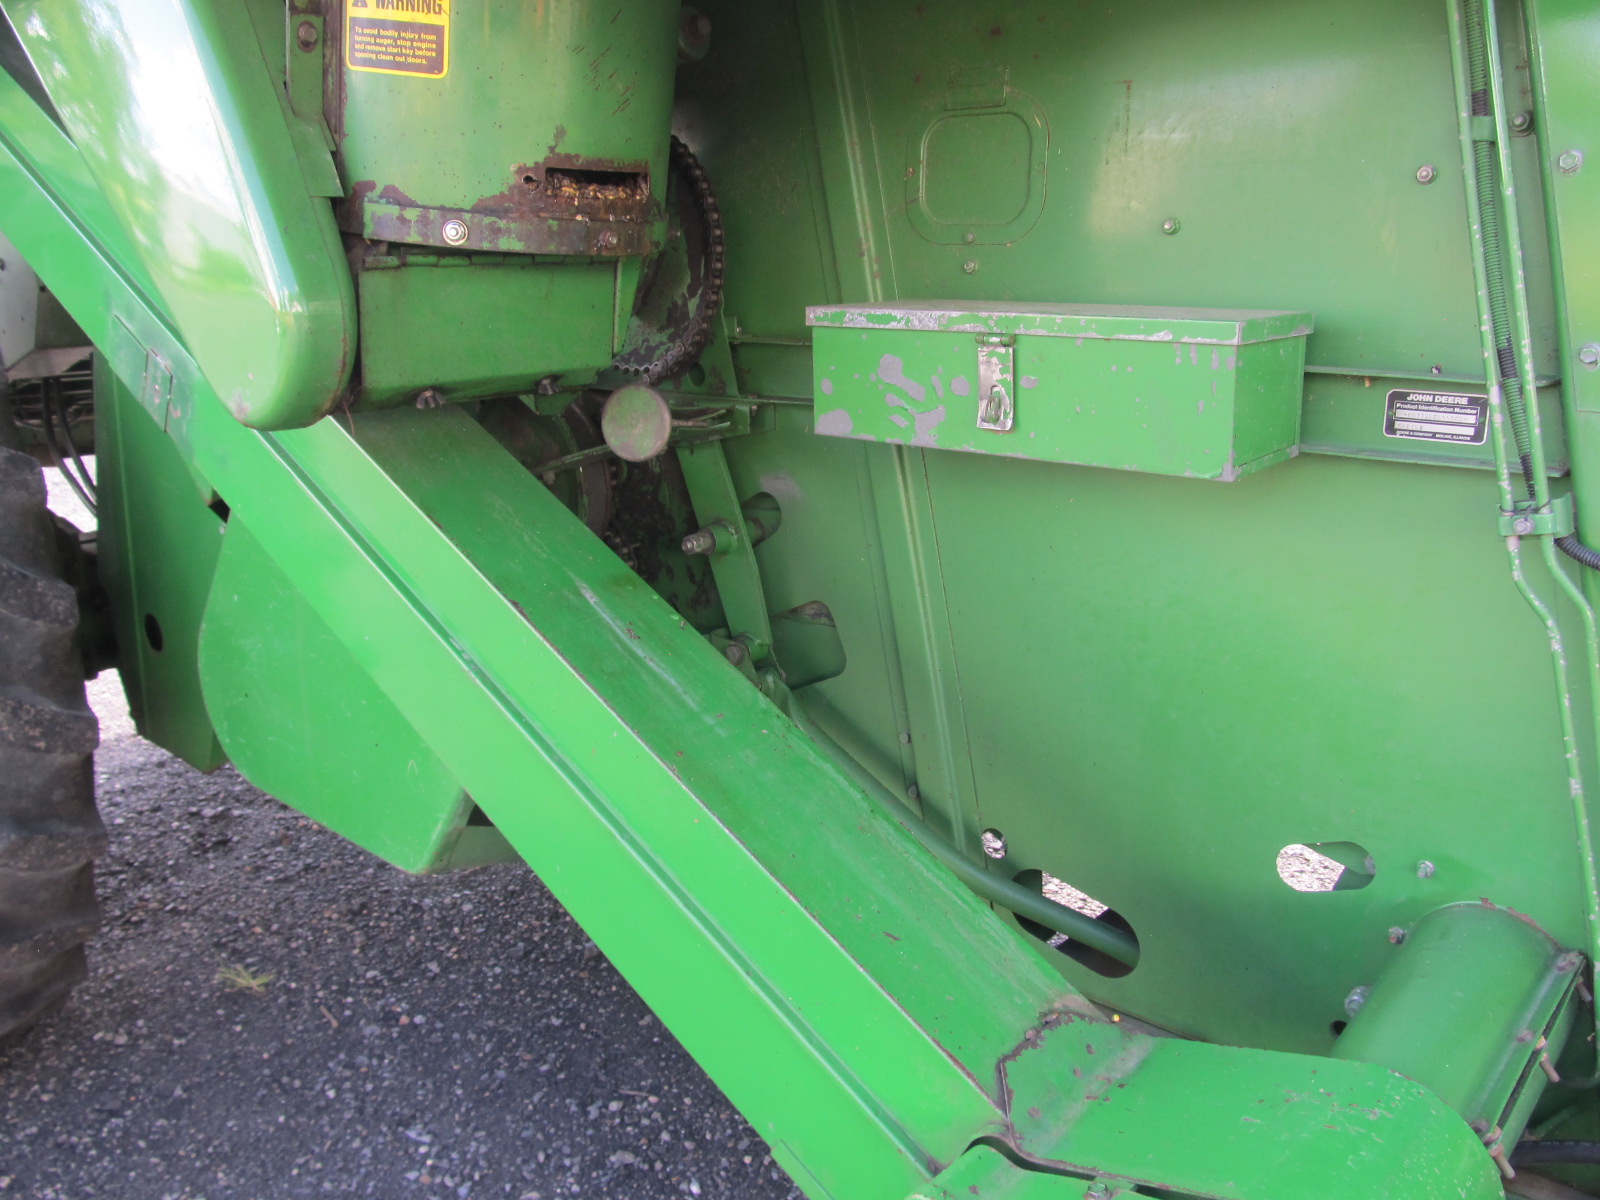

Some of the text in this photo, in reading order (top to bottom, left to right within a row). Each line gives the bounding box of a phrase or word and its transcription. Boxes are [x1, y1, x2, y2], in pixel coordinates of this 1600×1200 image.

[375, 0, 442, 15] WARNING
[380, 29, 398, 37] bodily
[401, 30, 418, 39] injury
[355, 35, 374, 43] turning
[402, 47, 413, 55] key
[408, 56, 428, 64] doors.
[1407, 394, 1468, 404] JOHN DEERE
